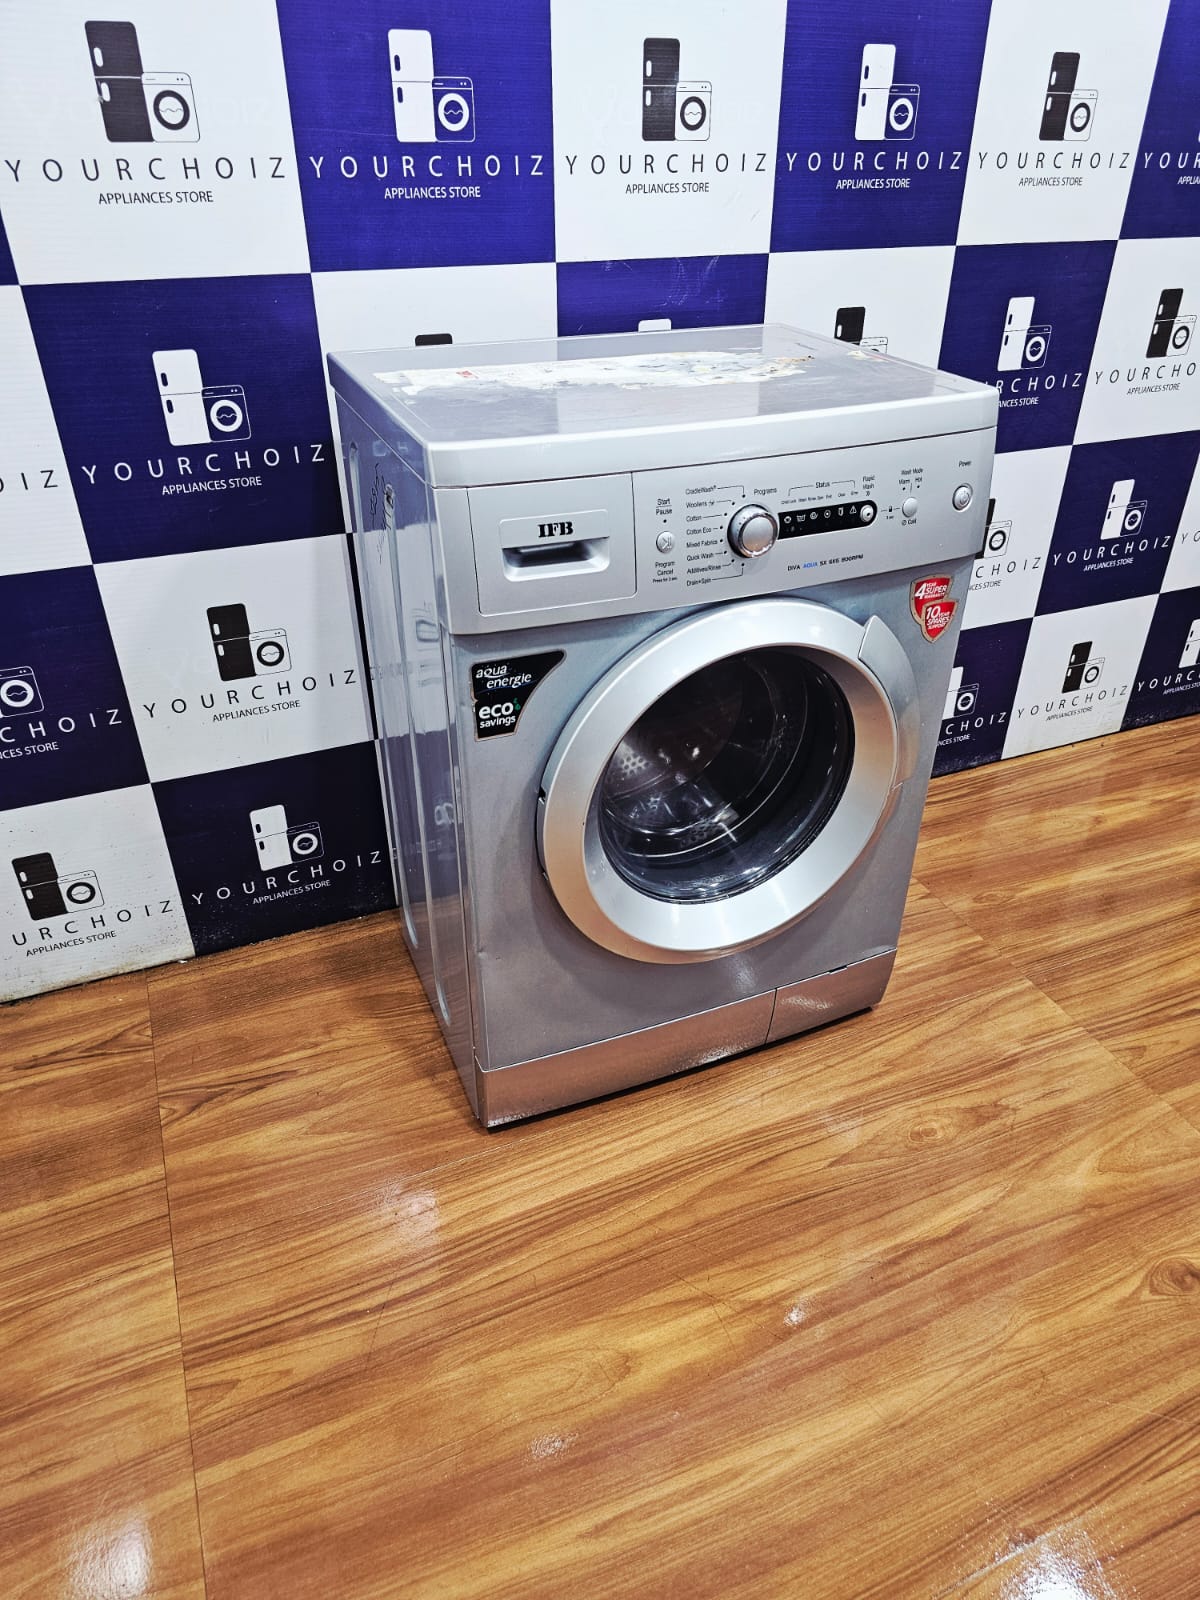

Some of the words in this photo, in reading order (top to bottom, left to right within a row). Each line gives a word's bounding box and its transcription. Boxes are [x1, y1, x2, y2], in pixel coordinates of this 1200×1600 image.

[310, 154, 544, 179] YOURCHOIZ
[566, 152, 767, 174] YOURCHOIZ
[785, 150, 962, 171] YOURCHOIZ
[978, 151, 1130, 169] YOURCHOIZ
[5, 157, 286, 183] YOURCHOIZ
[625, 183, 680, 194] APPLIANCES
[682, 181, 709, 192] STORE
[836, 180, 884, 189] APPLIANCES
[886, 178, 910, 188] STORE
[1019, 178, 1057, 187] APPLIANCES
[1059, 176, 1083, 186] STORE
[98, 192, 173, 204] APPLIANCES
[176, 190, 213, 203] STORE
[384, 187, 445, 199] APPLIANCES
[448, 185, 481, 198] STORE
[984, 373, 1082, 394] RCHOIZ
[1127, 384, 1161, 395] APPLIANCES
[1162, 382, 1181, 390] STORE
[1019, 396, 1040, 405] STORE
[82, 445, 325, 485] YOURCHOIZ
[162, 479, 226, 496] APPLIANCES
[228, 475, 262, 490] STORE
[753, 488, 777, 496] Programs
[815, 481, 830, 489] Status
[657, 498, 671, 506] Start
[537, 521, 574, 538] IFB
[686, 554, 700, 562] Quick
[1053, 536, 1171, 566] YOURCHOIZ
[654, 561, 676, 569] Program
[803, 561, 818, 569] AQUA
[1083, 560, 1116, 571] APPLIANCES
[1116, 557, 1134, 566] STORE
[914, 582, 927, 599] 4
[925, 585, 948, 594] SUPER
[926, 605, 940, 620] 10
[475, 664, 508, 678] aqua
[486, 673, 532, 688] energie
[143, 670, 356, 718] YOURCHOIZ
[1017, 685, 1128, 719] YOURCHOIZ
[212, 704, 269, 722] APPLIANCES
[271, 699, 300, 715] STORE
[478, 702, 514, 719] eco
[1046, 711, 1076, 721] APPLIANCES
[1077, 706, 1093, 714] STORE
[480, 715, 516, 728] savings
[953, 733, 971, 743] STORE
[24, 742, 59, 755] STORE
[191, 850, 382, 904] YOURCHOIZ
[252, 888, 303, 904] APPLIANCES
[304, 879, 331, 893] STORE
[26, 938, 84, 957] APPLIANCES
[86, 930, 117, 944] STORE
